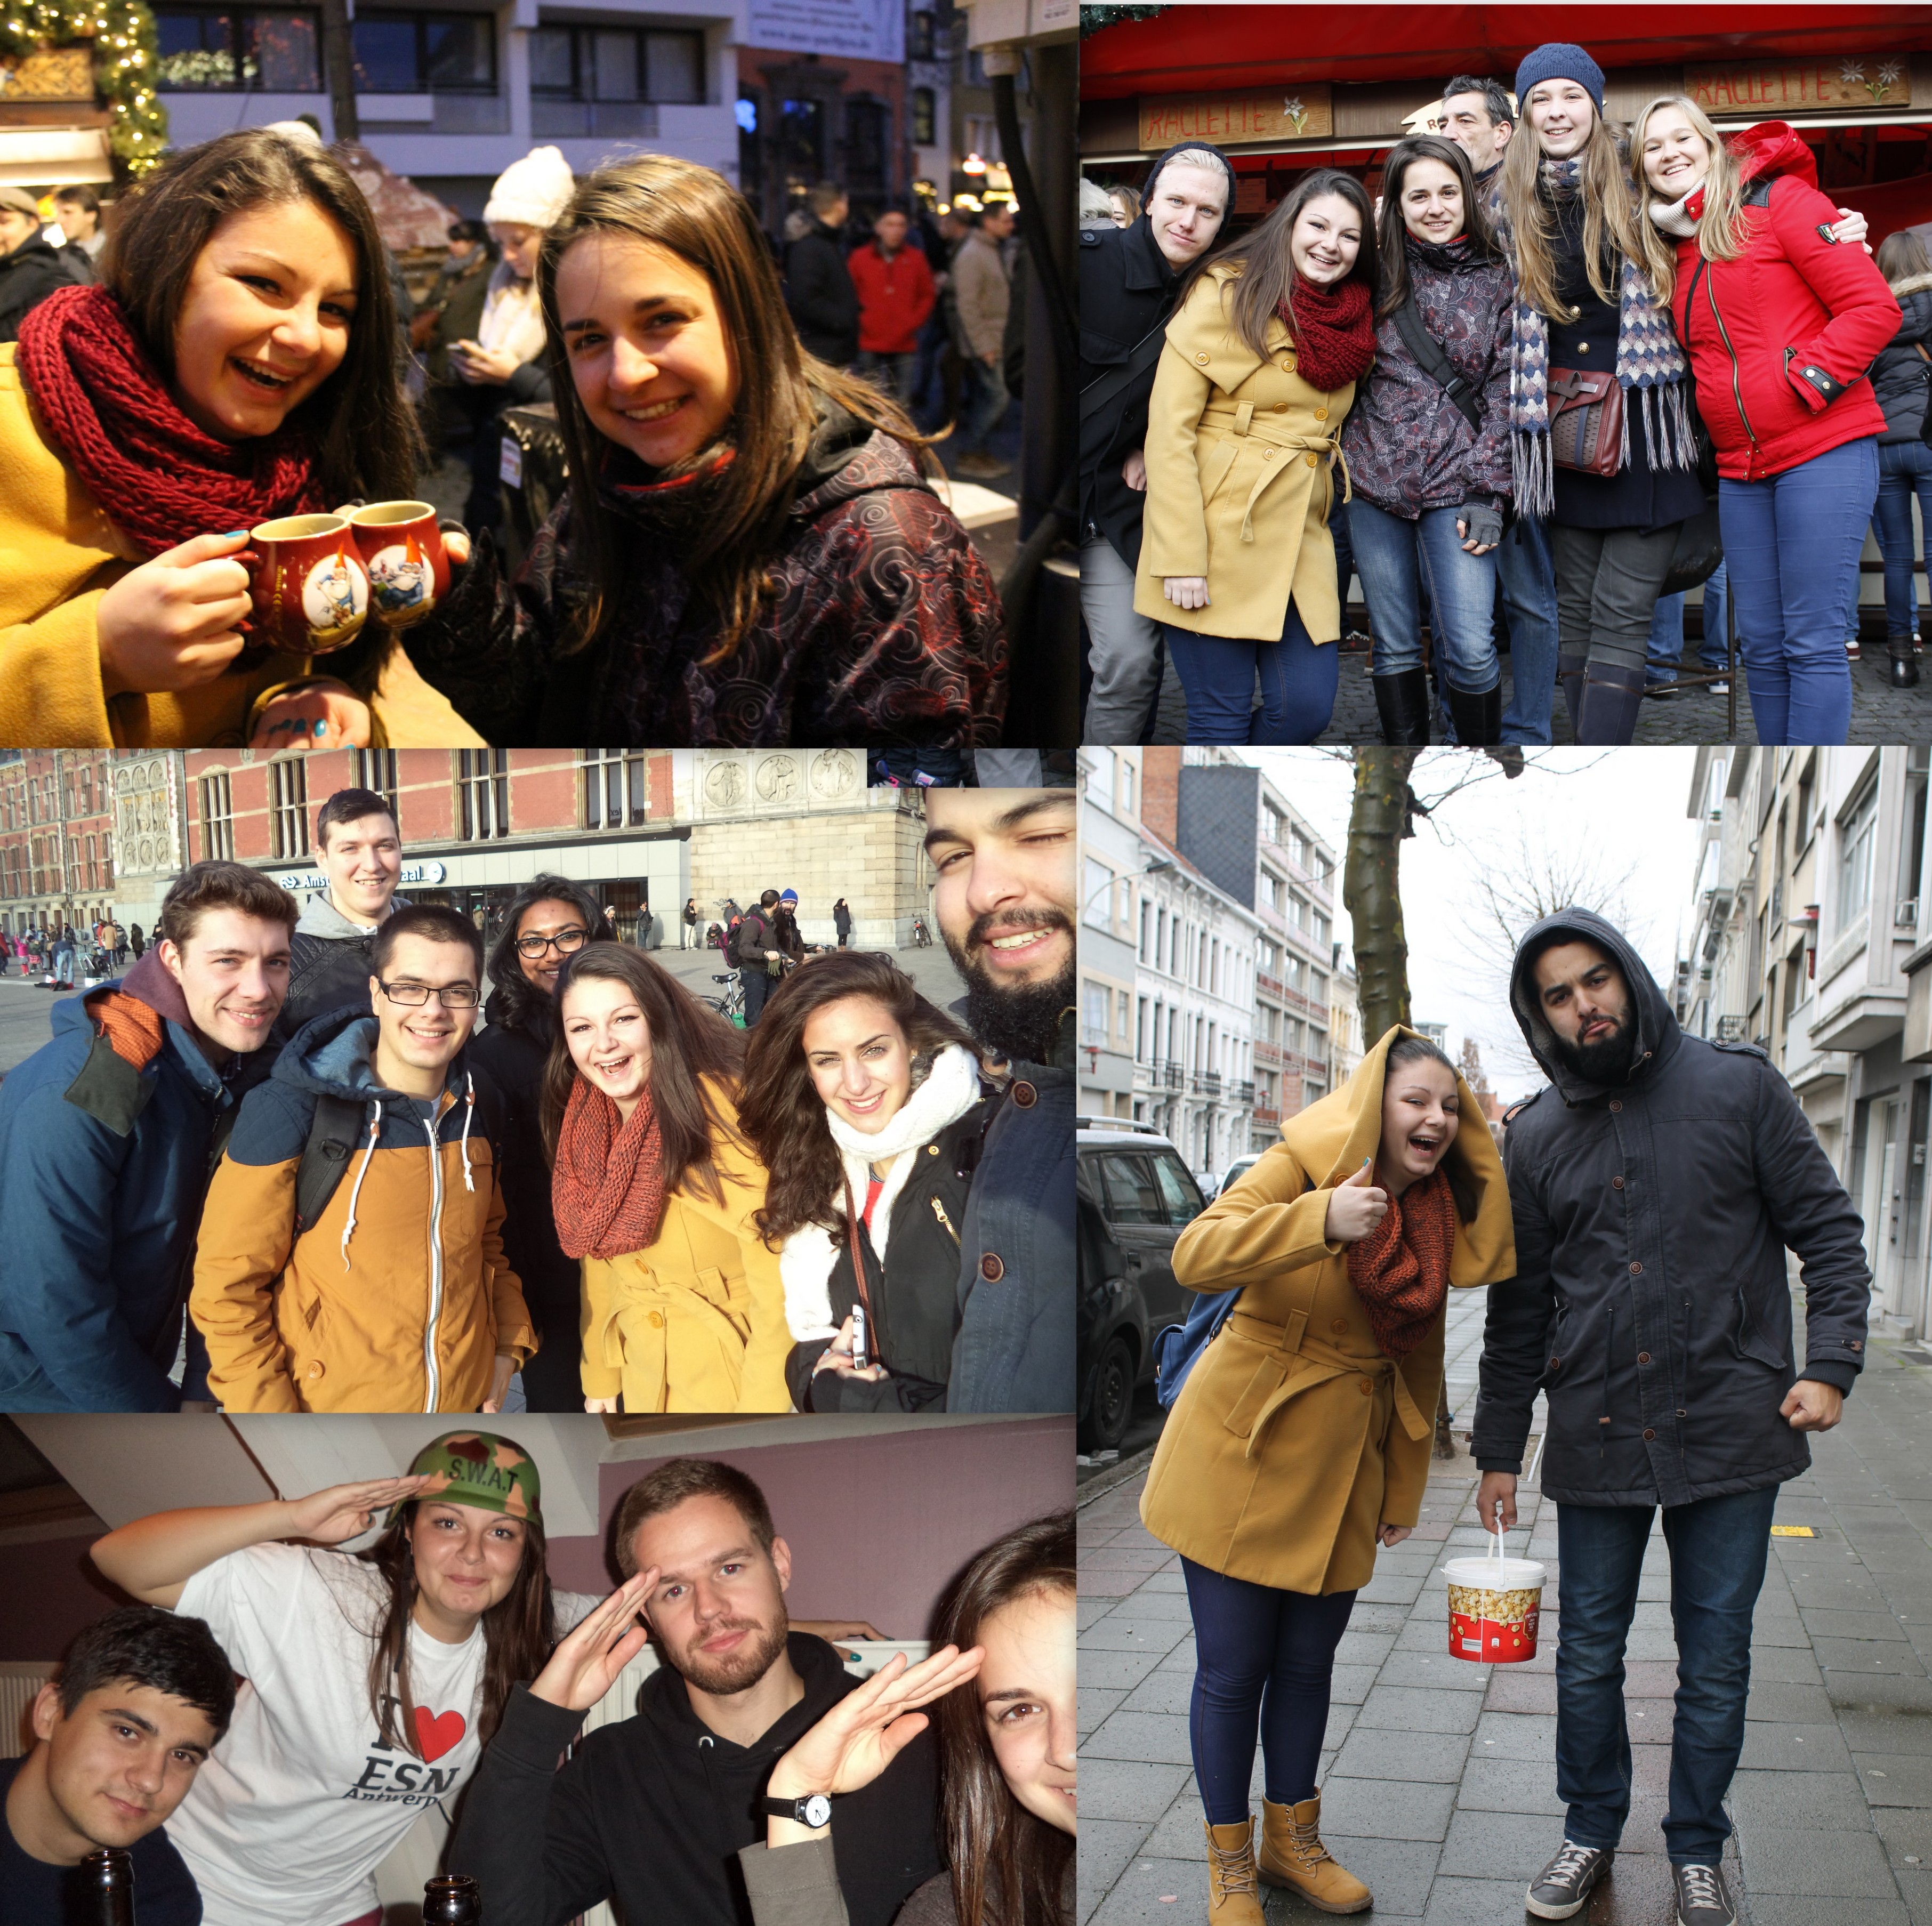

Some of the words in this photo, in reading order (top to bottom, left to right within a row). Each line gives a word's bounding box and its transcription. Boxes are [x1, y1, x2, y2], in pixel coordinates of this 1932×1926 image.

[1693, 65, 1830, 105] RACLETTE
[1147, 98, 1265, 140] RACLETTE
[303, 875, 329, 888] Amst
[400, 866, 420, 881] aal
[372, 1694, 401, 1751] I
[352, 1756, 461, 1793] ESN
[342, 1787, 438, 1810] Antwerp
